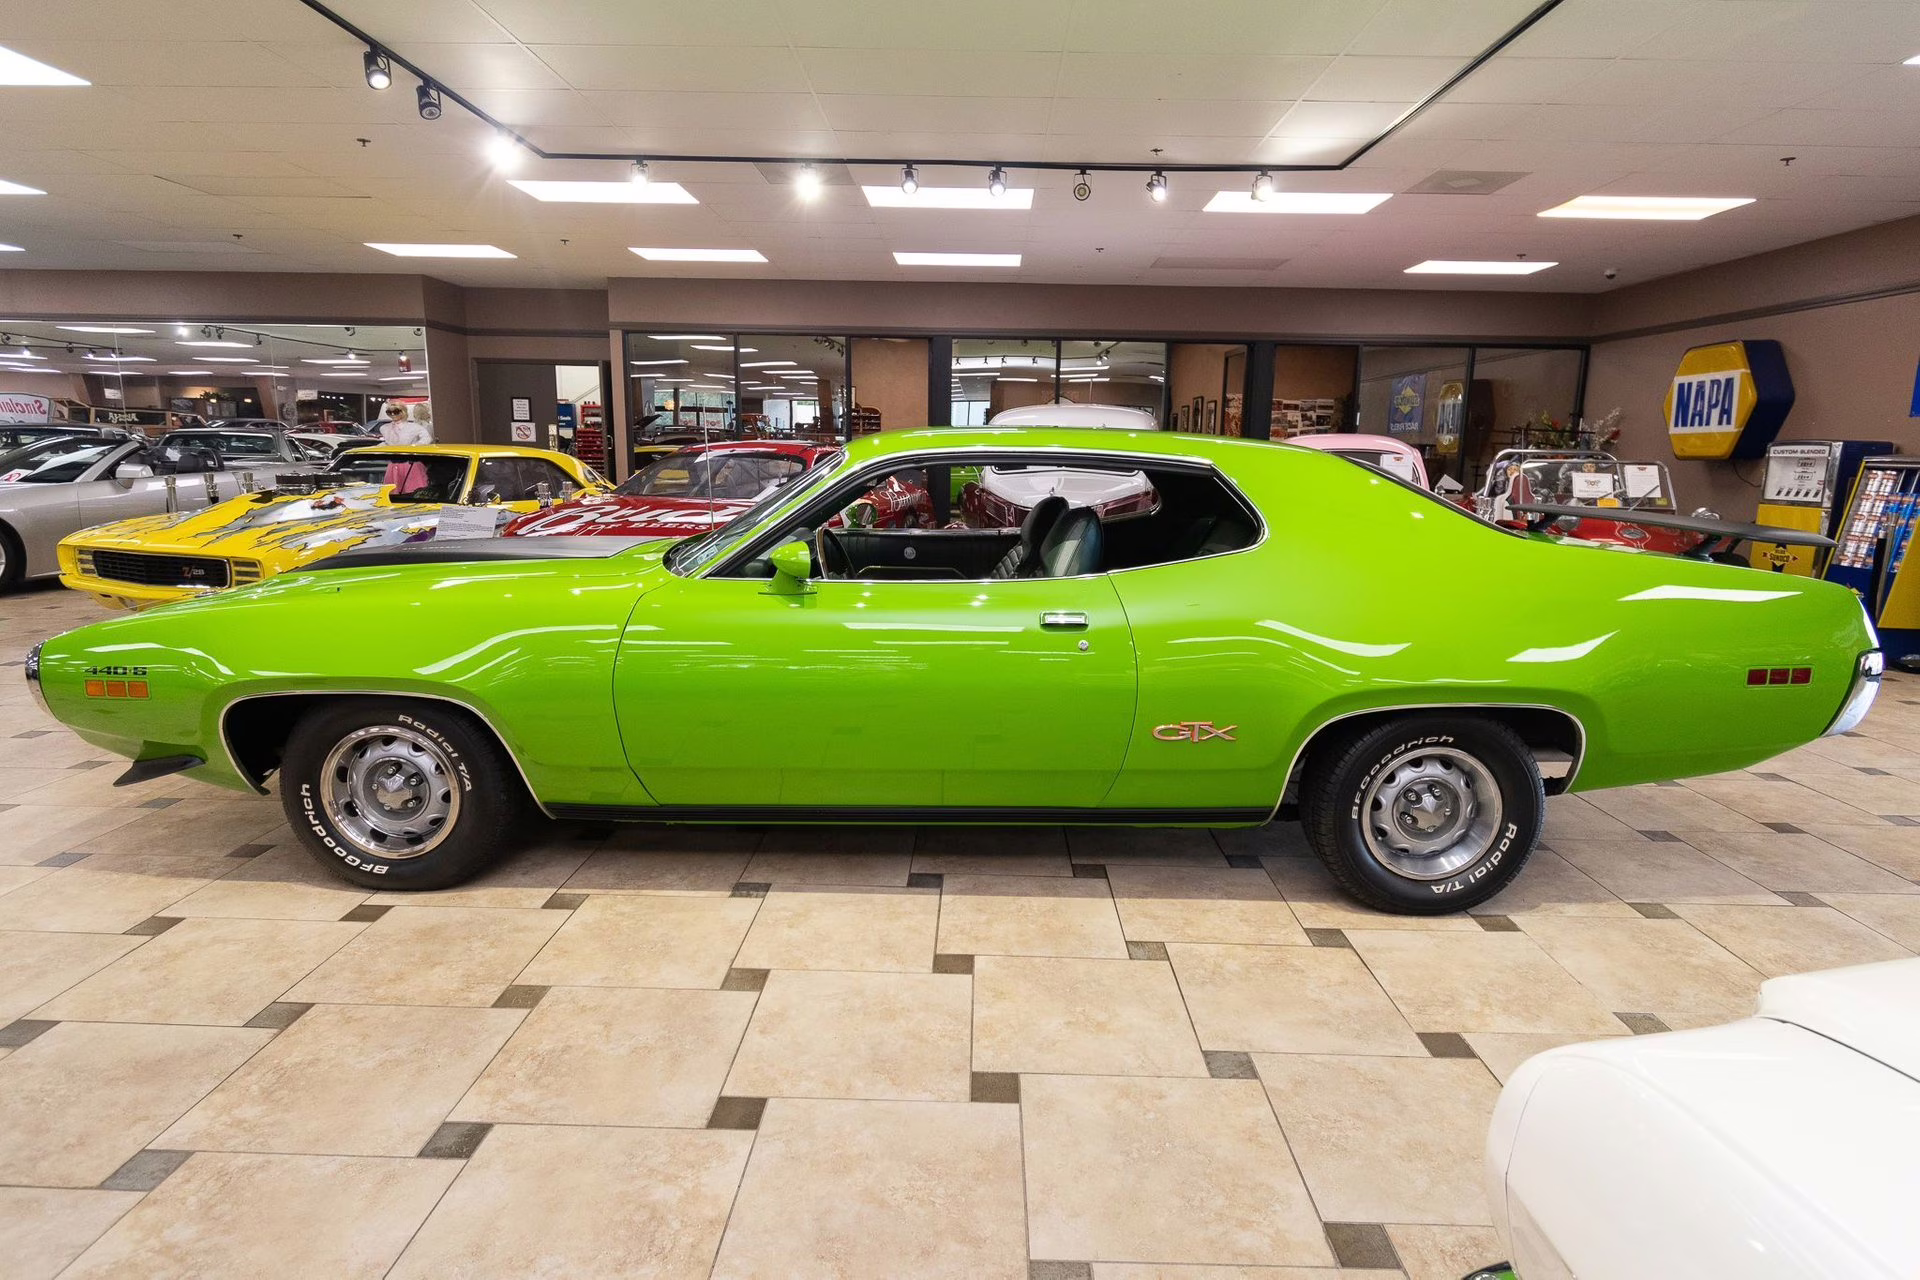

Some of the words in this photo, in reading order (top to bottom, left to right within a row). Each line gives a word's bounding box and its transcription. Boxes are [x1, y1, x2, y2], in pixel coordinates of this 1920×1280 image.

[1674, 377, 1734, 428] NAPA
[627, 522, 710, 530] BEERS
[1769, 553, 1790, 563] SUNOCO
[398, 714, 458, 759] Radial
[458, 762, 473, 792] T/A
[1152, 721, 1238, 743] GTX
[1351, 735, 1455, 820] BFGoodrich
[300, 783, 389, 876] BFGoodrich
[1470, 822, 1518, 884] Radial
[1430, 880, 1465, 895] T/A
